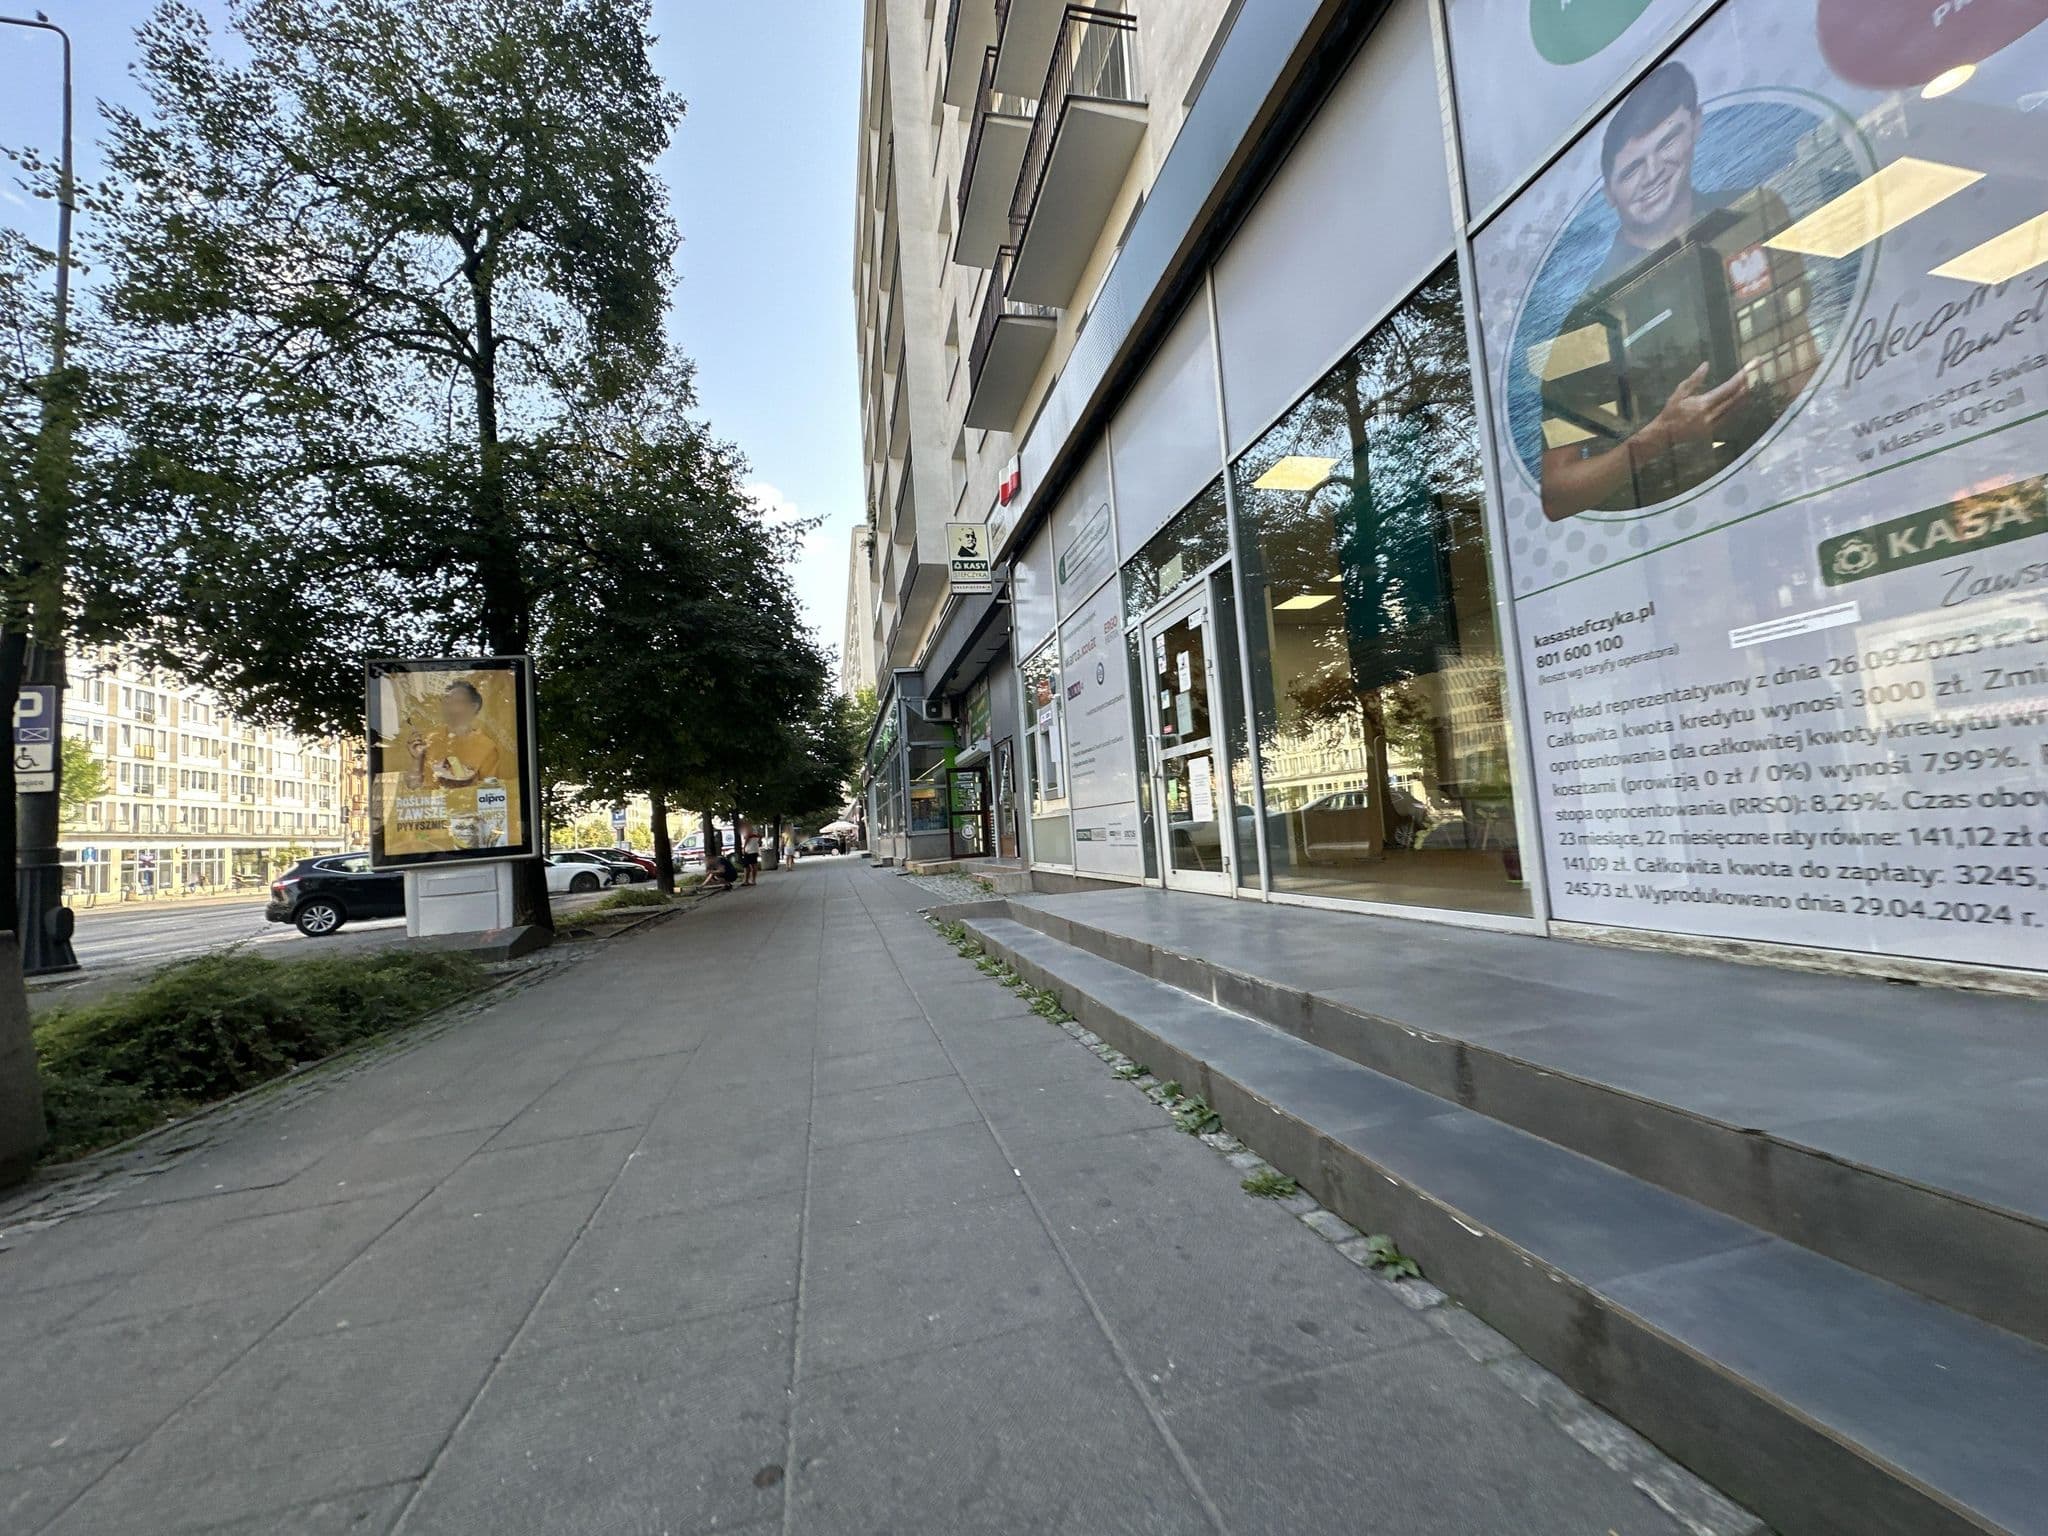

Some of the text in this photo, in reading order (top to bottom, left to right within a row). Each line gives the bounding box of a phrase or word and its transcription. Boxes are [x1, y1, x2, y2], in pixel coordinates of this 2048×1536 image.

[1852, 379, 1982, 438] Wicemistrz
[1856, 448, 1875, 462] w
[1878, 421, 1945, 455] klasie
[1887, 501, 2033, 559] KASA
[963, 562, 986, 570] KASY
[1534, 602, 1656, 648] kasastefczyka.pl
[1536, 635, 1624, 668] 801 600 100
[1543, 701, 1602, 726] Przykład
[1605, 677, 1751, 715] reprezentatywny
[1755, 675, 1769, 688] z
[1772, 664, 1821, 686] dnia
[1825, 633, 1982, 676] 26.09.2023
[12, 691, 43, 728] P
[1546, 727, 1618, 749] Całkowita
[1621, 718, 1675, 738] kwota
[1678, 707, 1755, 730] kredytu
[1761, 694, 1844, 722] wynosi
[1851, 680, 1926, 707] 3000
[1936, 673, 1972, 697] zł.
[1550, 746, 1666, 775] oprocentowania
[1669, 743, 1697, 761] dla
[1700, 732, 1803, 757] całkowitej
[1806, 724, 1882, 746] kwoty
[1886, 715, 1999, 739] kredytu
[1552, 778, 1616, 797] kosztami
[1620, 771, 1699, 795] (prowizją
[1704, 770, 1718, 786] 0
[1724, 767, 1742, 785] zł
[1749, 766, 1760, 784] /
[1766, 761, 1812, 784] 0%)
[1818, 755, 1912, 783] wynosi
[1919, 746, 2030, 774] 7,99%.
[397, 807, 448, 820] ZAWSZE
[479, 793, 505, 805] alpro
[1556, 806, 1594, 822] stopa
[1595, 799, 1727, 822] oprocentowania
[1729, 795, 1808, 816] (RRSO):
[1810, 791, 1899, 814] 8,29%.
[1902, 790, 1973, 810] Czas
[1558, 832, 1576, 846] 23
[1577, 830, 1643, 849] miesiące,
[1646, 830, 1666, 845] 22
[1669, 828, 1769, 849] miesięczne
[1772, 829, 1816, 849] raty
[1906, 825, 1997, 850] 141,12
[2002, 824, 2033, 847] zł
[1562, 856, 1608, 873] 141,09
[1612, 856, 1631, 872] zł.
[1634, 856, 1723, 875] Całkowita
[1728, 858, 1793, 877] kwota
[1800, 859, 1831, 878] do
[1836, 861, 1947, 888] zapłaty:
[1565, 881, 1612, 897] 245,73
[1635, 883, 1791, 909] Wyprodukowano
[1795, 892, 1848, 914] dnia
[1852, 895, 2013, 925] 29.04.2024
[2020, 911, 2044, 928] r.
